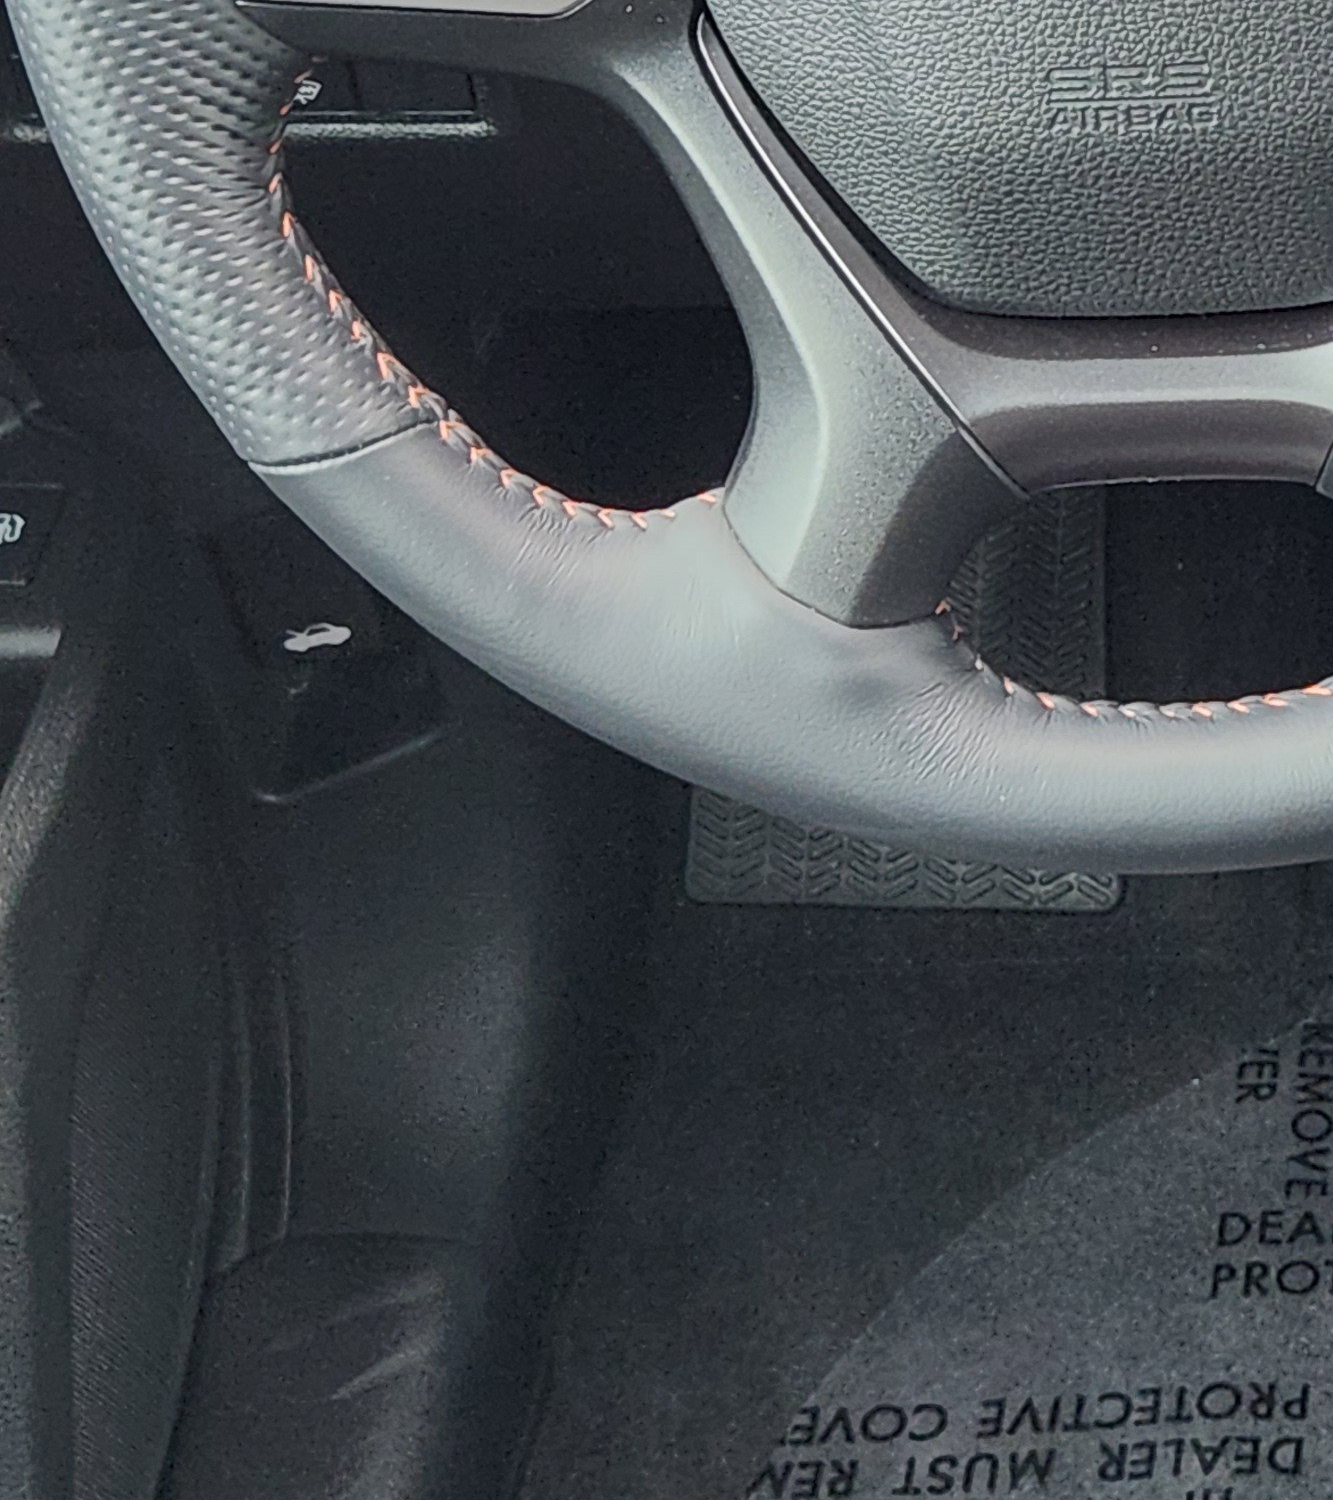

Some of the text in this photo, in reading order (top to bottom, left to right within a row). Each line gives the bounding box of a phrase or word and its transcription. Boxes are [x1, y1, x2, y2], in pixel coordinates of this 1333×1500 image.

[782, 1381, 1312, 1447] PROTECTIVE COVE
[891, 1447, 1057, 1496] MUST
[1097, 1436, 1304, 1483] DEALER
